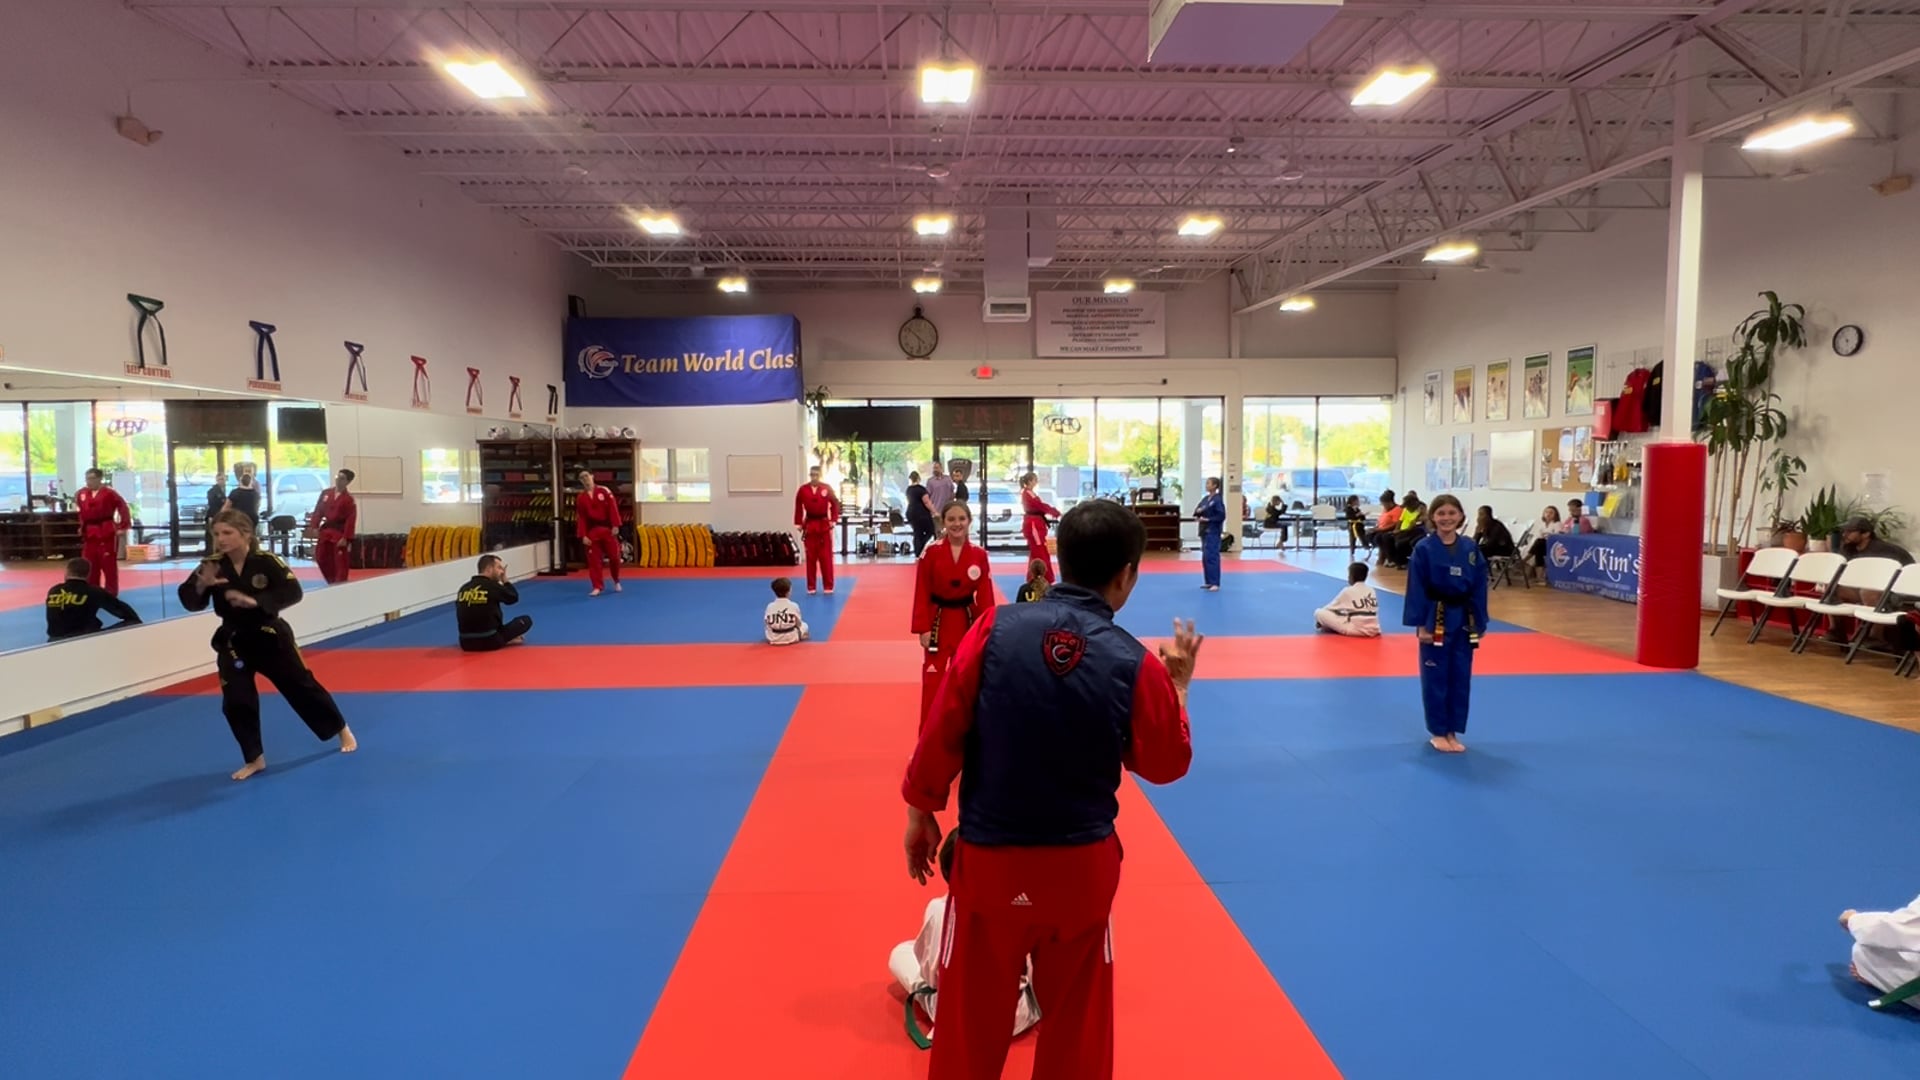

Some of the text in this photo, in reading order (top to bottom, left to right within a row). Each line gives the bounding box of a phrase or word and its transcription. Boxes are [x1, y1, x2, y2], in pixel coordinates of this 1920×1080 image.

[1071, 296, 1129, 305] OUR MISSION
[621, 353, 679, 373] Team
[683, 348, 745, 372] World
[767, 611, 797, 625] UNI
